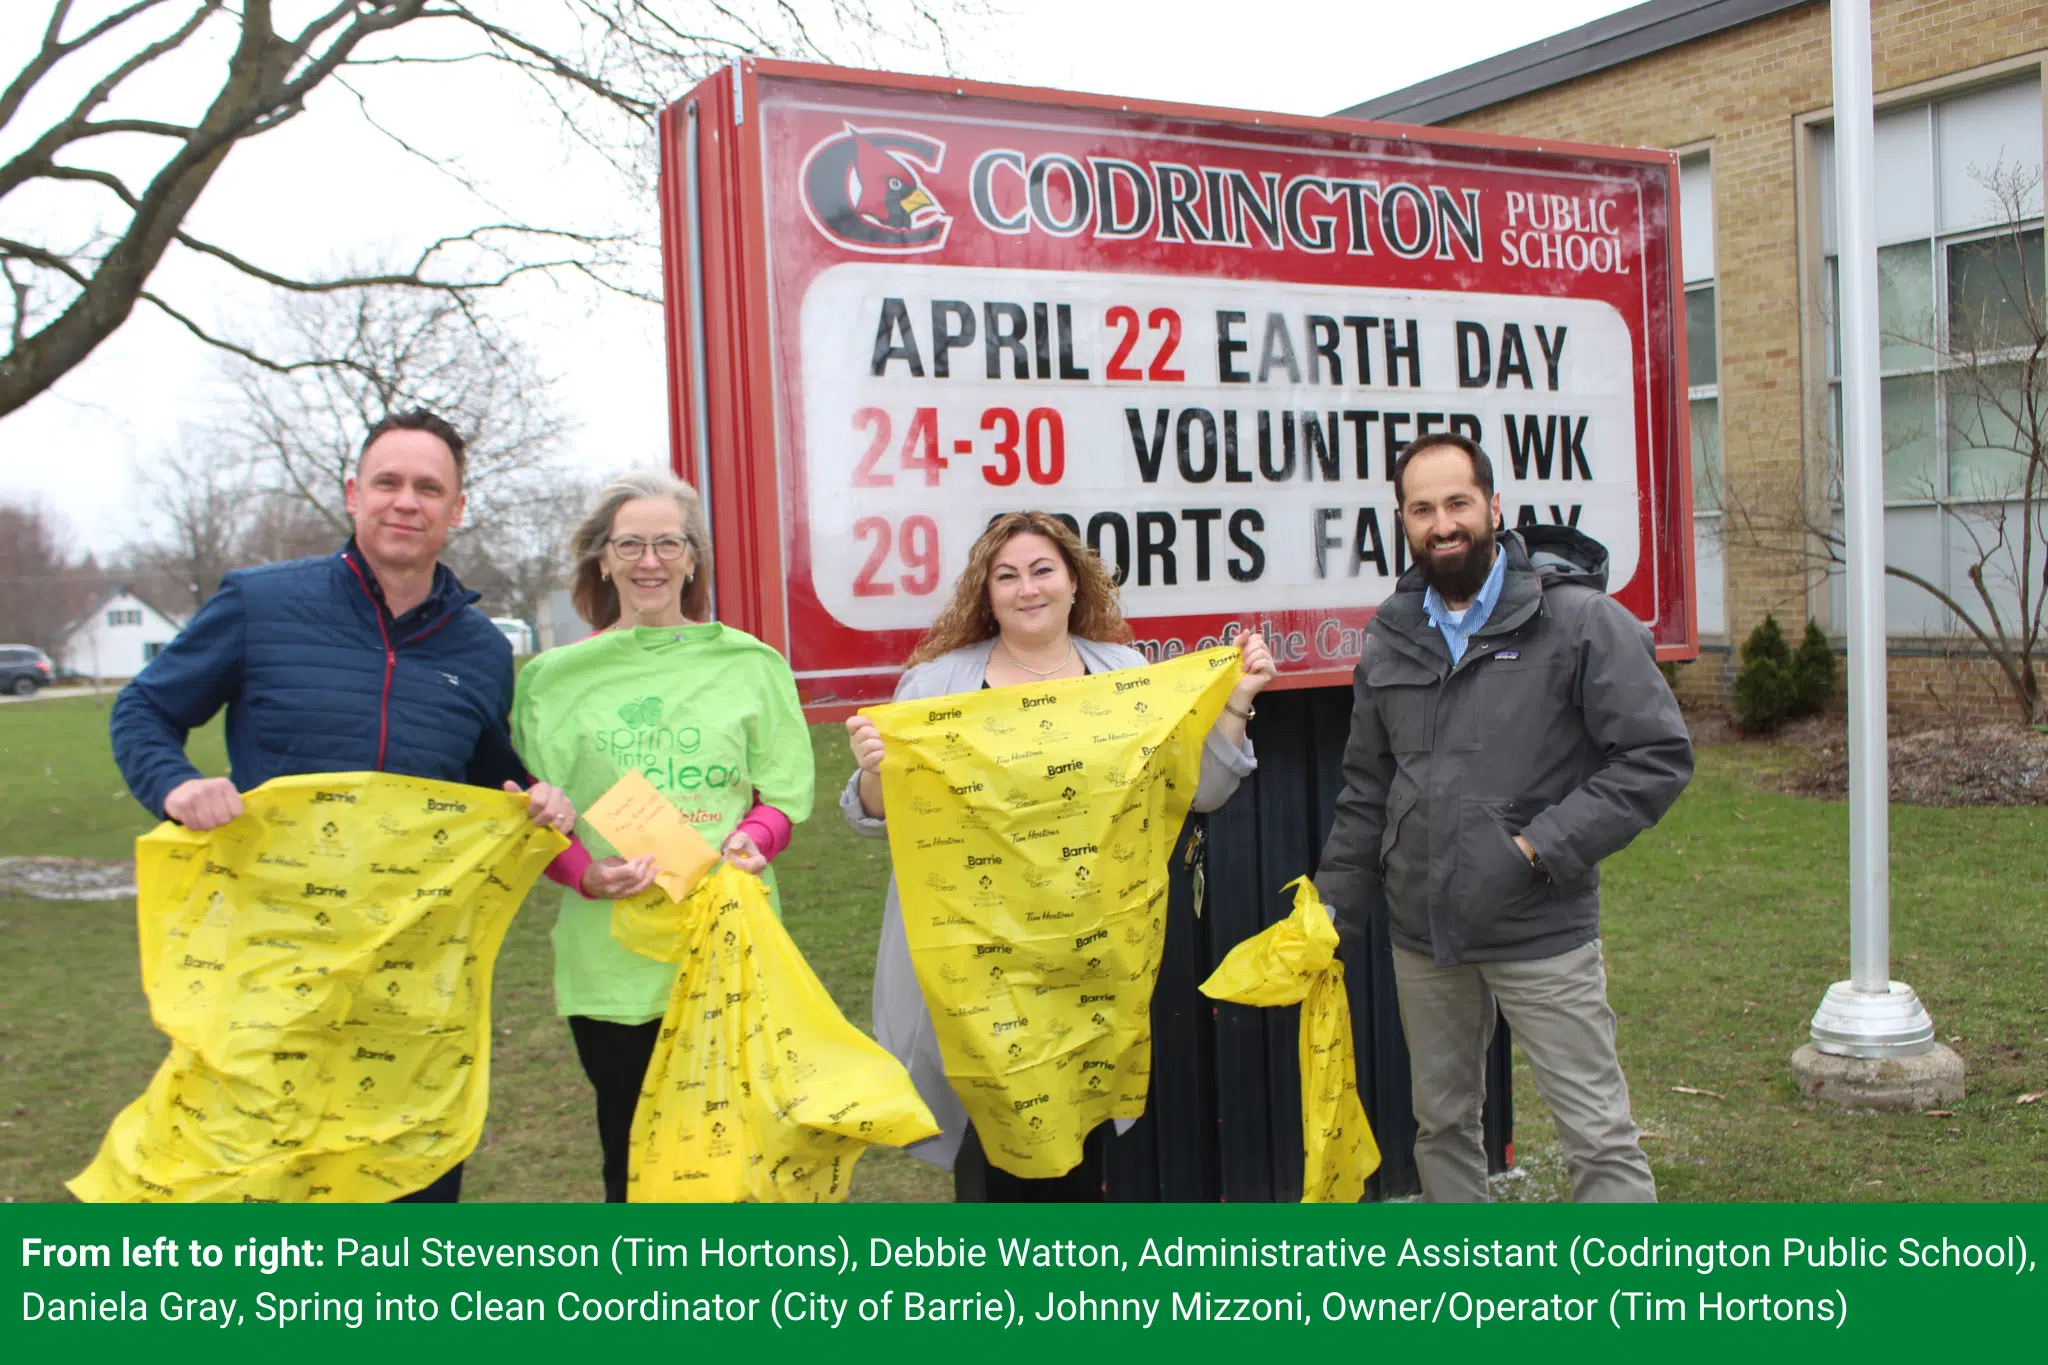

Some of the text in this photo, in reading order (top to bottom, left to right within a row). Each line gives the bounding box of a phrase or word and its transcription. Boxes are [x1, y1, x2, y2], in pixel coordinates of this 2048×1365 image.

[968, 149, 1483, 263] CODRINGTON
[1505, 191, 1619, 235] PUBLIC
[1500, 230, 1630, 275] SCHOOL
[870, 297, 1568, 392] APRIL 22 EARTH DAY
[851, 406, 1593, 488] 24-30 VOLUNTE WK
[852, 515, 940, 597] 29
[987, 507, 1267, 587] ORTS
[1252, 621, 1306, 661] he
[1115, 677, 1151, 692] Barrie
[1022, 694, 1057, 709] Barrie
[929, 708, 963, 722] Barrie
[596, 726, 701, 754] spring
[617, 750, 657, 767] into
[644, 756, 741, 790] clean
[1047, 759, 1083, 776] Barrie
[427, 799, 467, 813] Barrie
[1062, 843, 1098, 858] Barrie
[967, 855, 1003, 866] Barrie
[305, 883, 347, 898] Barrie
[1076, 929, 1108, 948] Barrie
[977, 944, 1012, 955] Barrie
[184, 955, 225, 971] Barrie
[1080, 994, 1116, 1003] Barrie
[993, 1016, 1029, 1032] Barrie
[356, 1047, 396, 1062] Barrie
[1014, 1094, 1049, 1110] Barrie
